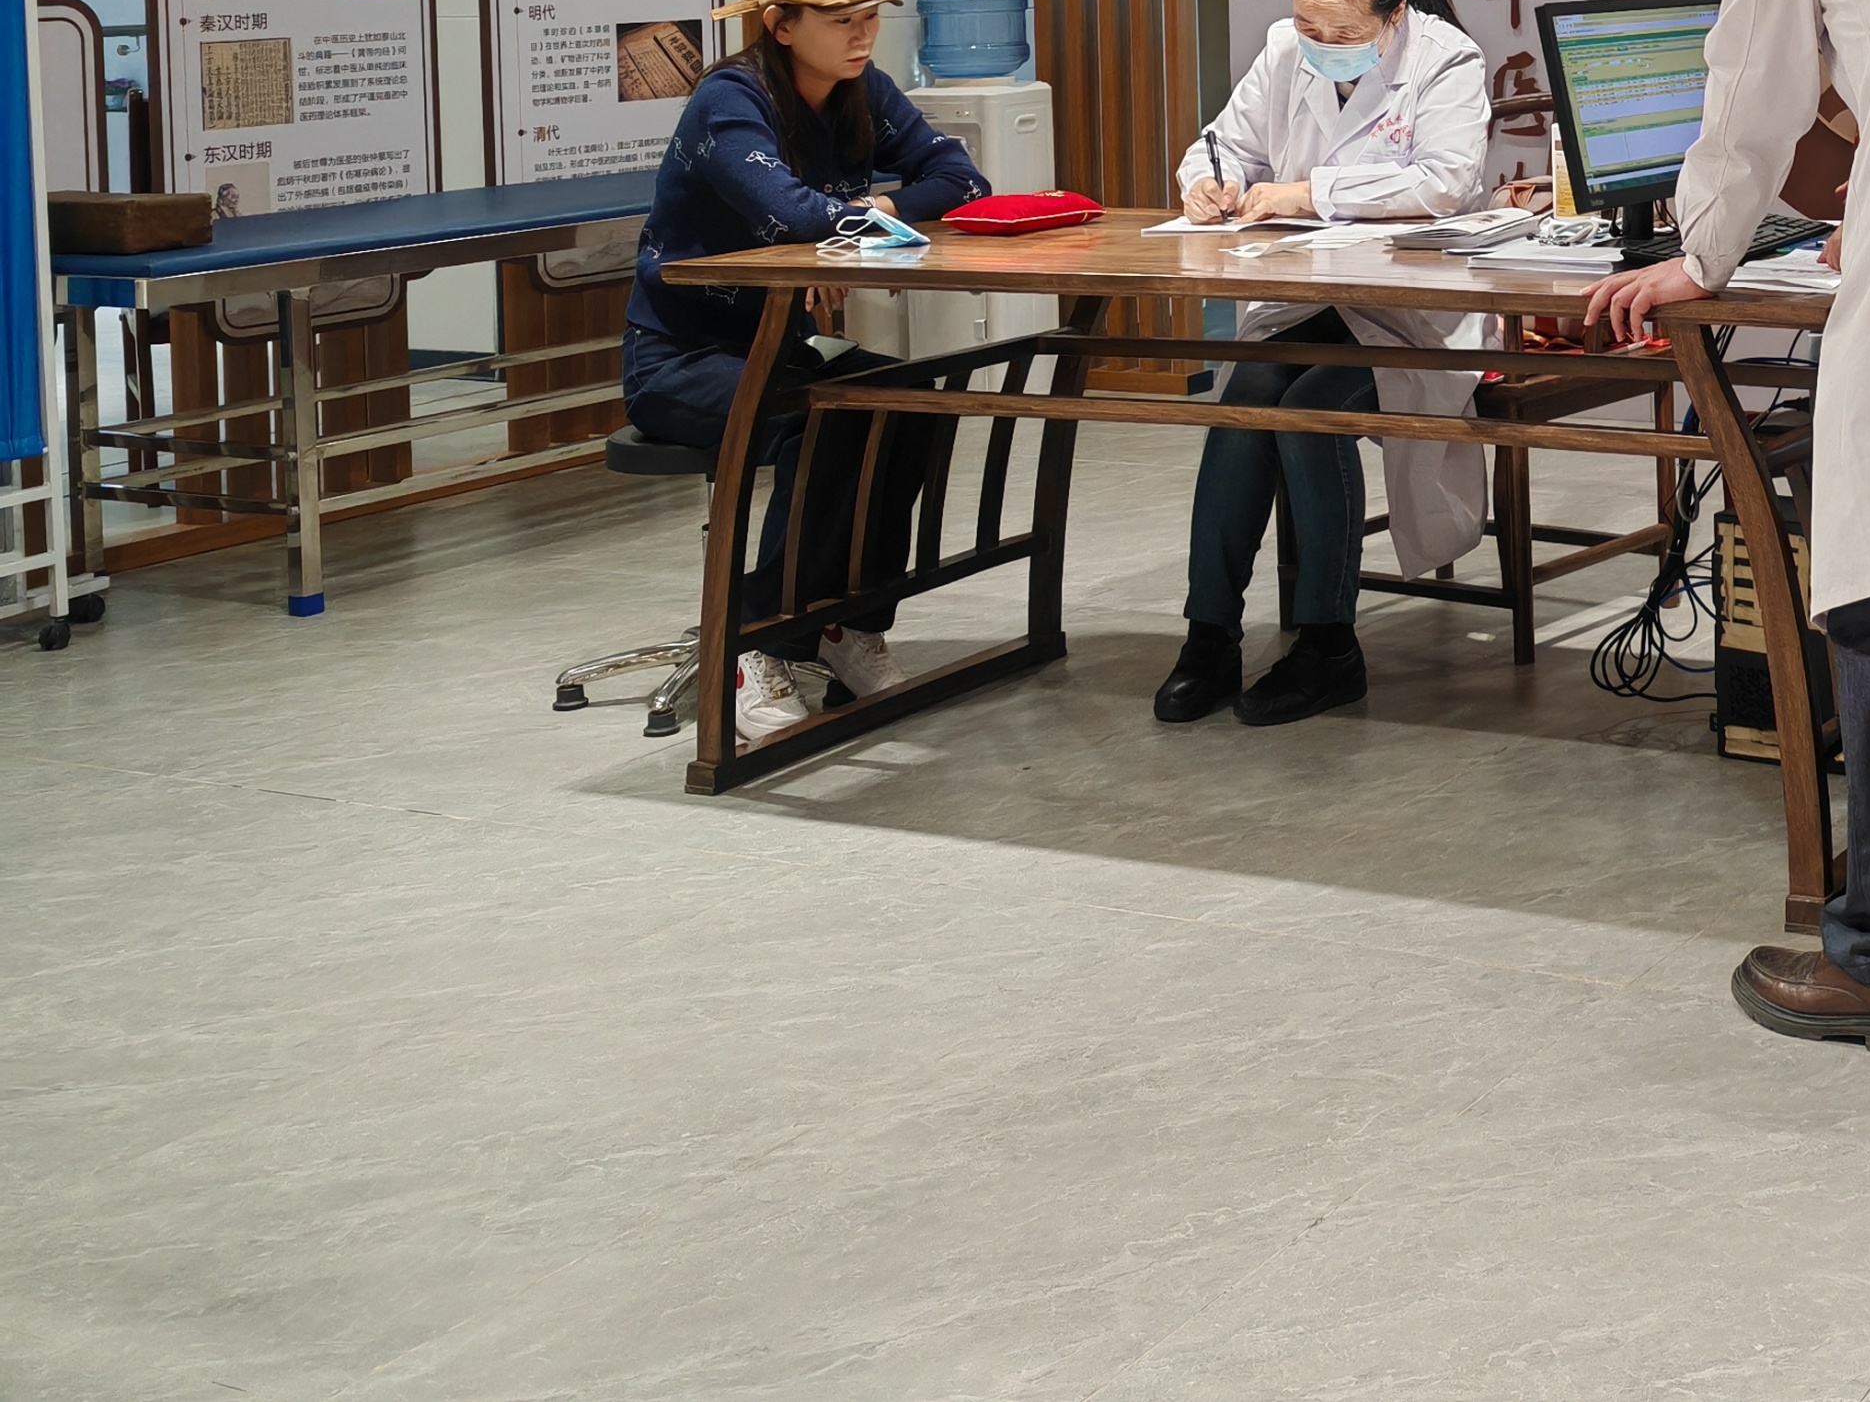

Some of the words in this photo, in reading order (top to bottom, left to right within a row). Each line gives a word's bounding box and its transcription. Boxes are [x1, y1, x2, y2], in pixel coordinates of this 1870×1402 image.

[528, 4, 556, 21] 明代
[199, 13, 268, 33] 秦汉时期
[533, 125, 560, 143] 清代
[203, 141, 272, 164] 东汉时期
